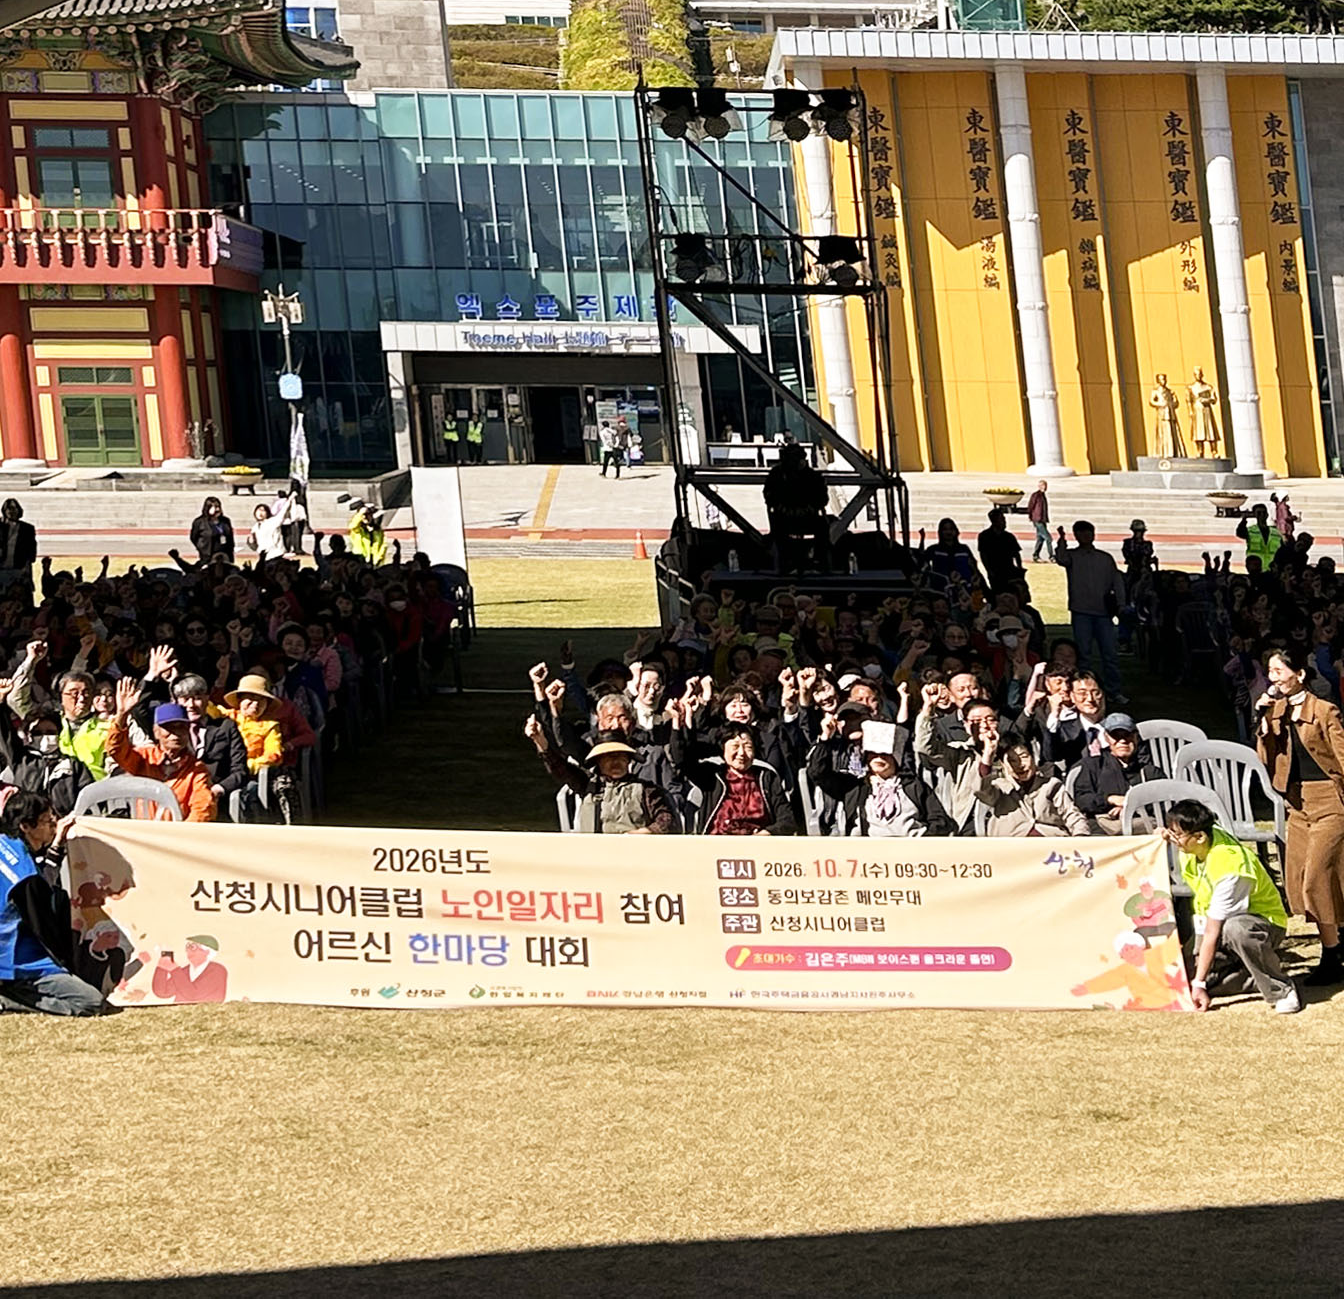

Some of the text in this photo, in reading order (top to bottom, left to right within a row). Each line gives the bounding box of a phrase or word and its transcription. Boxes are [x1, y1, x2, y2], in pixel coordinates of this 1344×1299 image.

[867, 106, 900, 220] 東醫寶鑑
[964, 107, 999, 221] 東醫寶鑑
[1063, 108, 1099, 222] 東醫寶鑑
[1162, 110, 1199, 224] 東醫寶鑑
[1262, 112, 1298, 225] 東醫寶鑑
[372, 847, 492, 875] 2026년도
[719, 860, 753, 879] 일시
[763, 862, 807, 878] 2026.
[812, 859, 842, 878] 10.
[894, 863, 993, 879] 09:30~12:30
[1043, 849, 1095, 879] 산청
[189, 879, 686, 926] 산청시니어클럽 노인일자리 참여
[721, 887, 922, 906] 장소 동의보감촌 메인무대
[724, 914, 887, 933] 주관 산청시니어클럽
[293, 929, 590, 968] 어르신 한마당 대회
[753, 953, 795, 964] 초대가수
[350, 988, 371, 998] 후원
[405, 988, 447, 998] 산청군
[586, 989, 619, 998] BNK
